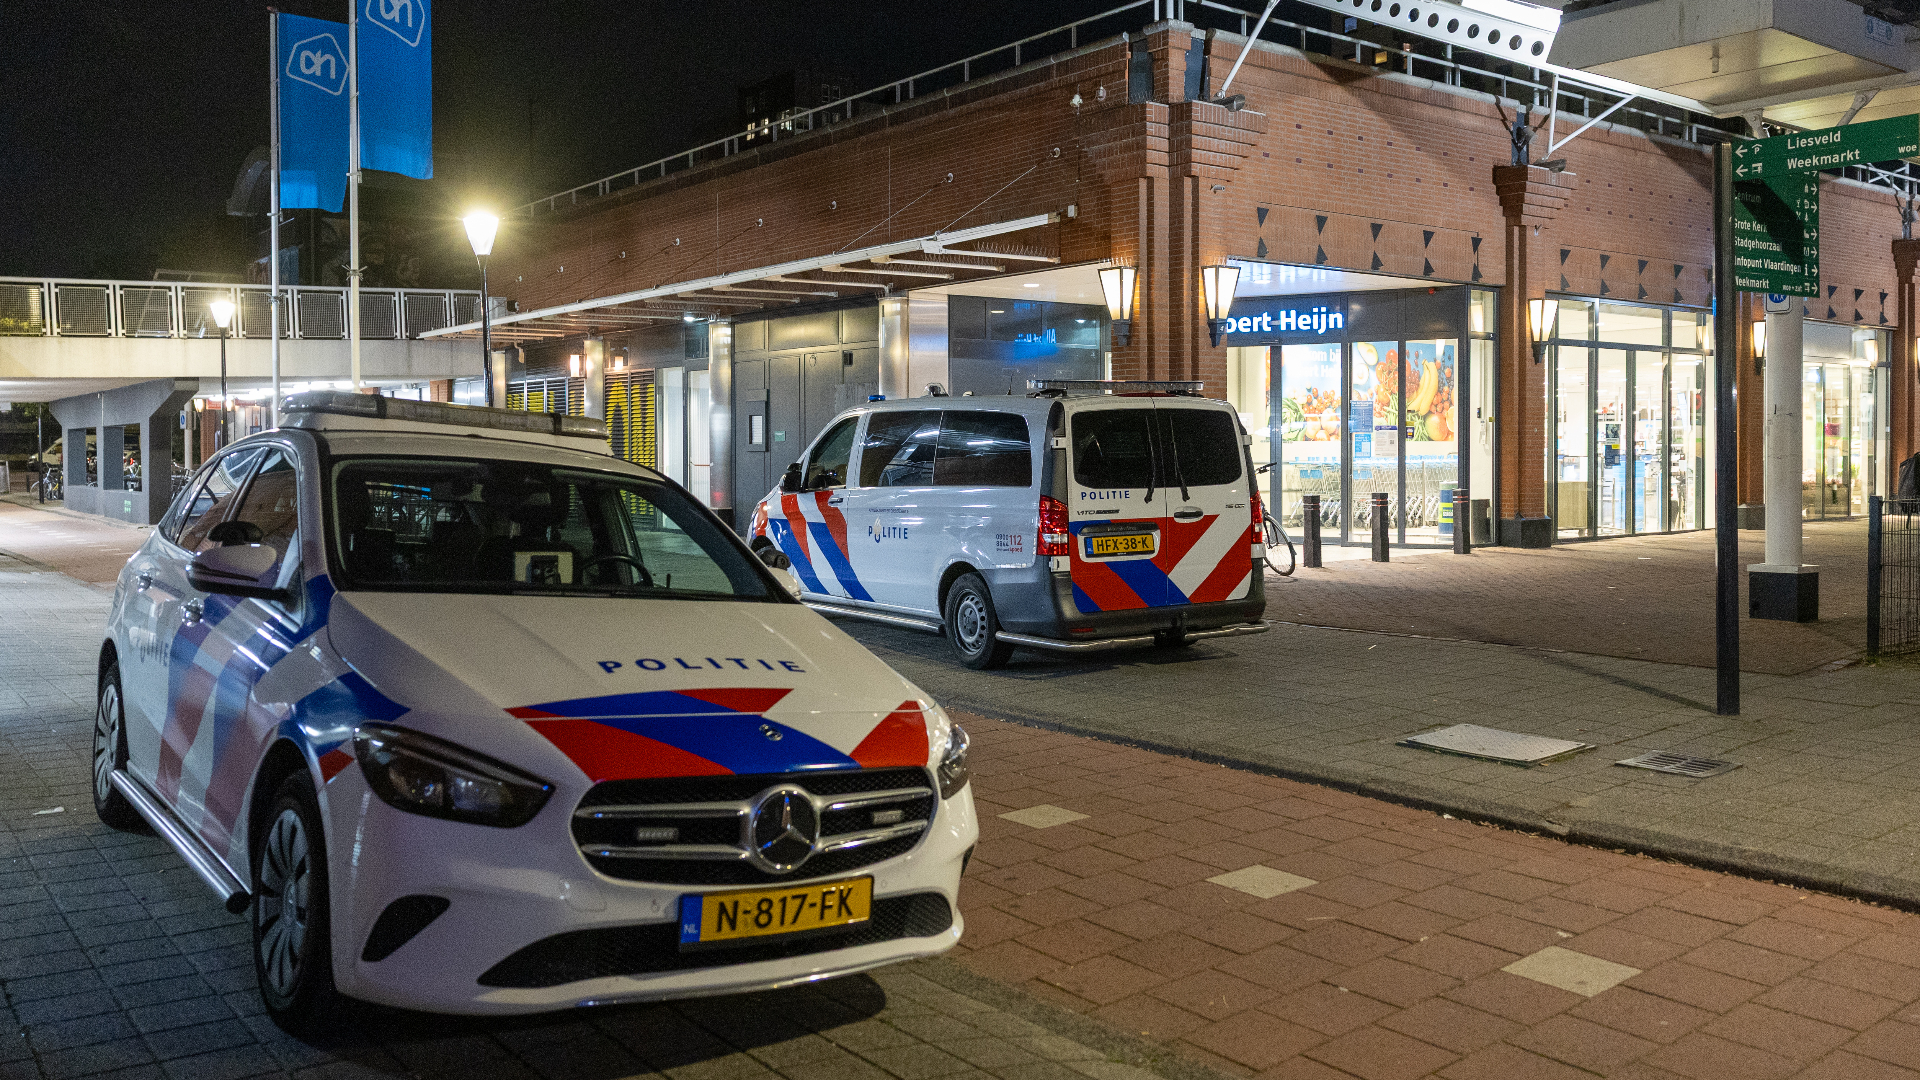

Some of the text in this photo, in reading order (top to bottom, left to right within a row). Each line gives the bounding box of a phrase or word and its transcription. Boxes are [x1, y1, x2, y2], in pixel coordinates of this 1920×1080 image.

[1787, 130, 1841, 150] Liesveld
[1787, 143, 1917, 170] Weekmarkt woe
[1734, 190, 1762, 203] entrum
[1734, 255, 1802, 275] Infopunt Vlaardingen
[1279, 306, 1344, 334] Heijn
[1081, 490, 1130, 500] POLITIE
[1009, 534, 1022, 546] 112
[1096, 536, 1150, 552] HFX-38-K
[597, 657, 806, 674] POLITIE
[683, 885, 854, 935] NL N-817-FK
